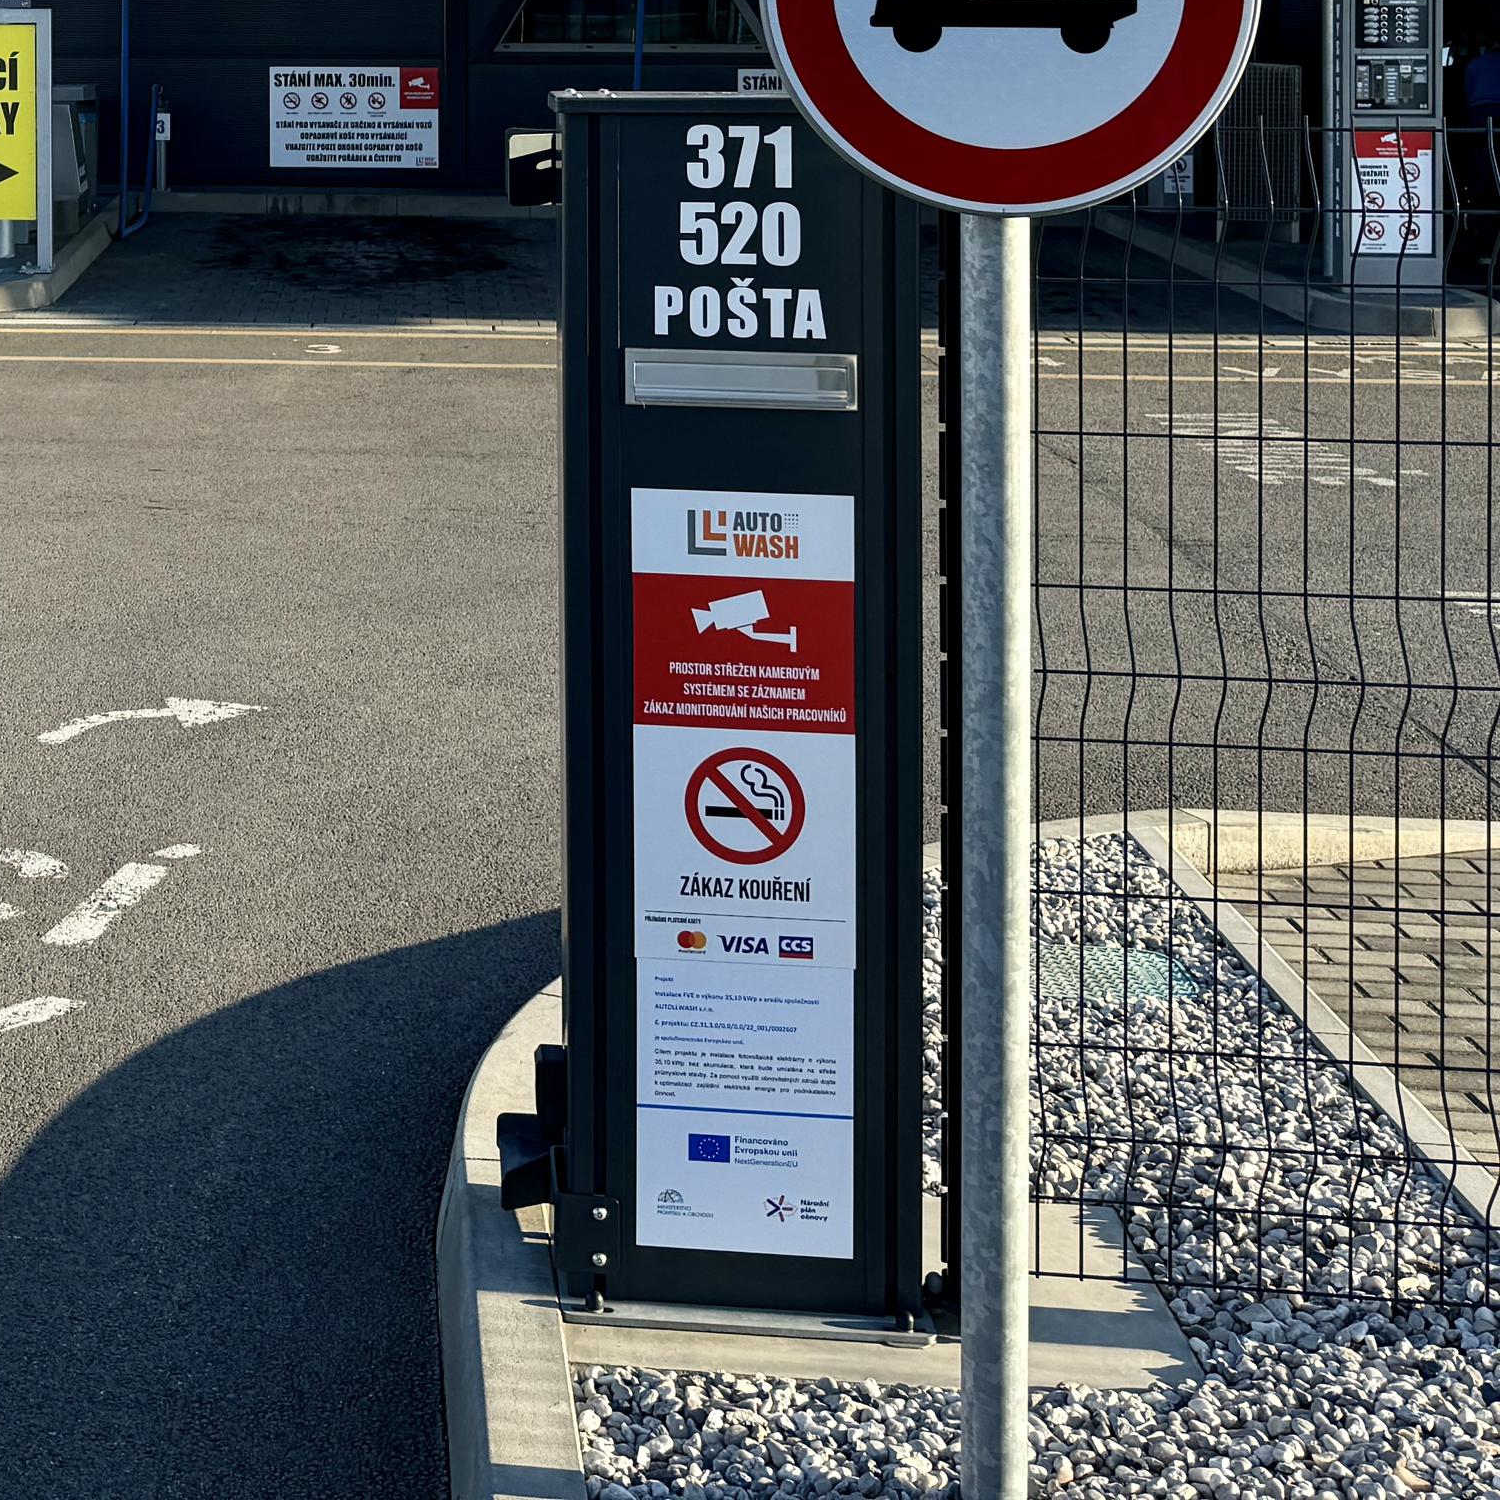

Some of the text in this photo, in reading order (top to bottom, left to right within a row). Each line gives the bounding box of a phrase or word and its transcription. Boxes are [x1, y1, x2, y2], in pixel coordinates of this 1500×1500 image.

[274, 70, 395, 88] STÁNÍ MAX. 30min.
[157, 120, 165, 134] 3
[686, 124, 793, 189] 371
[679, 201, 801, 267] 520
[654, 277, 827, 340] POŠTA
[303, 344, 342, 354] 3
[732, 511, 782, 532] AUTO
[733, 534, 799, 559] WASH
[669, 662, 820, 680] PROSTOR STŘEŽEN KAMEROVÝM
[683, 682, 806, 700] SYSTÉMEM SE ZÁZNAMEM
[643, 699, 846, 723] ZÁKAZ MONITOROVÁNÍ NAŠICH PRACOVNÍKŮ
[680, 872, 811, 902] ZÁKAZ KOUŘENÍ
[716, 934, 769, 955] VISA
[780, 939, 812, 952] CCS
[734, 1135, 789, 1146] Financováno
[734, 1146, 779, 1156] Evropskou
[734, 1158, 798, 1168] NextGenerationEU
[800, 1199, 830, 1207] Národní
